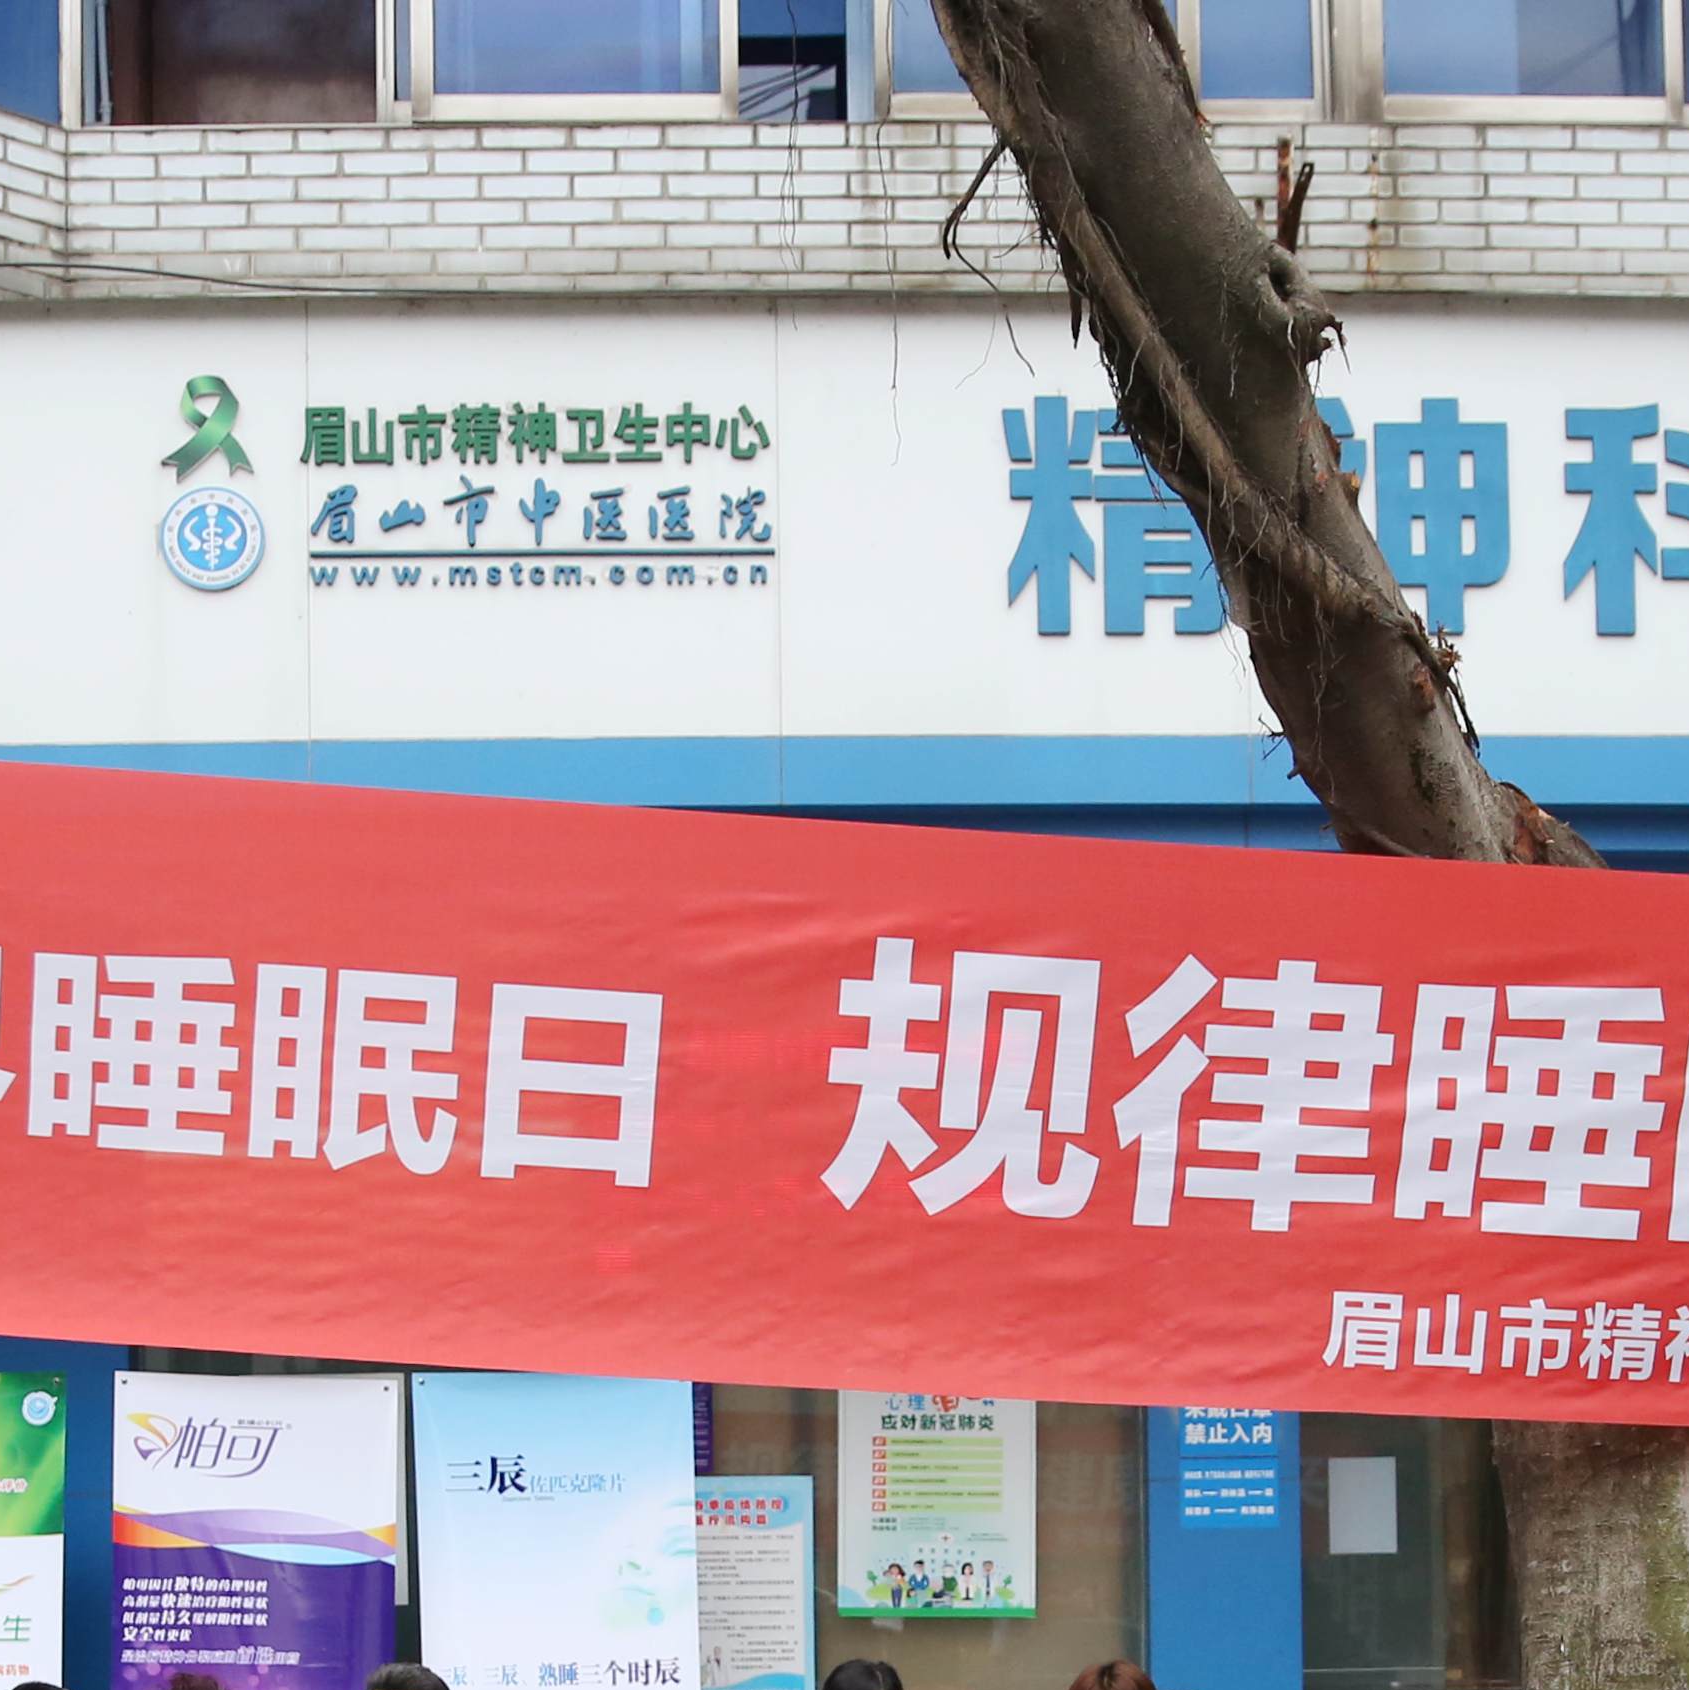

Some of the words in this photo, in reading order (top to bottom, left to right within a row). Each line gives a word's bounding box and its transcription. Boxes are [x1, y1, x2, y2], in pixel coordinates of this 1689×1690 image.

[300, 402, 770, 466] 眉山市精神卫生中心
[311, 474, 772, 547] 眉山市中医医院
[310, 562, 768, 586] www.mstcm.com.cn
[881, 1413, 995, 1431] 应对新冠肺炎
[1184, 1423, 1273, 1444] 禁止入内
[445, 1454, 527, 1495] 三辰
